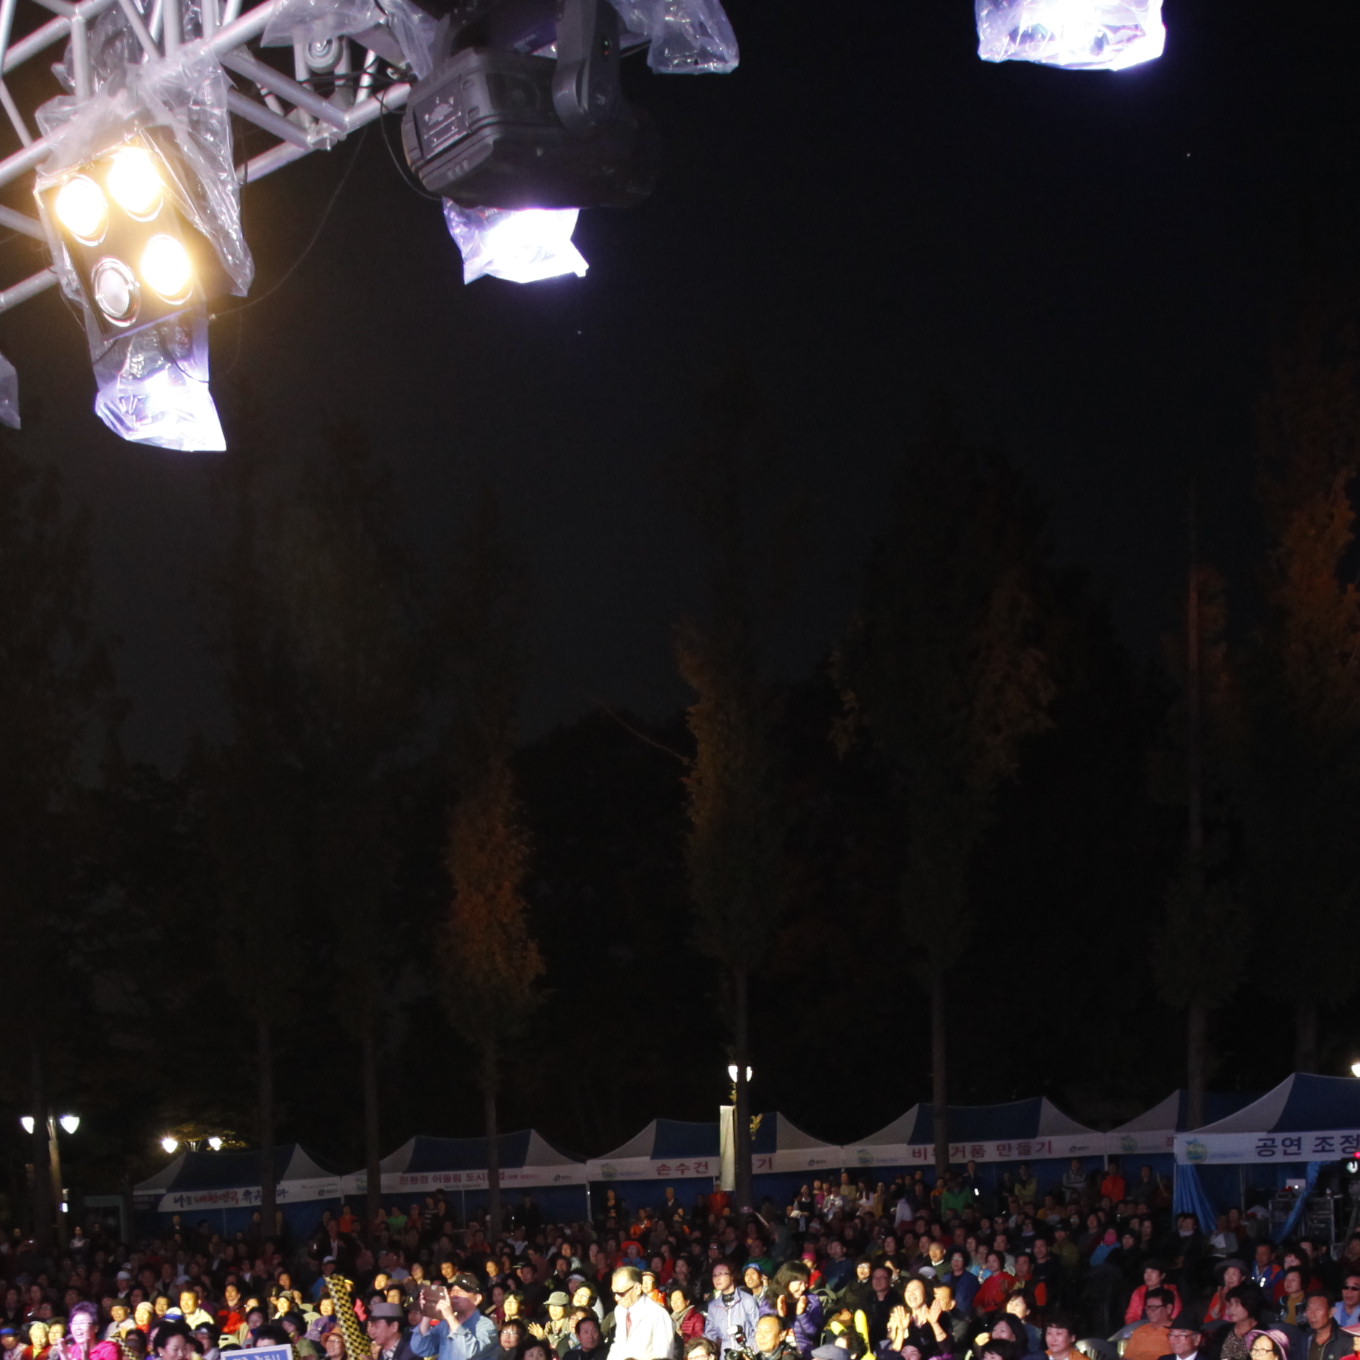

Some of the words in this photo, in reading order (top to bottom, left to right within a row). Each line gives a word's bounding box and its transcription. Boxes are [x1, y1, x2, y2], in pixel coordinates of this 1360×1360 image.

[996, 1139, 1053, 1157] 만들기
[1255, 1137, 1302, 1157] 공연
[655, 1161, 710, 1176] 손수건
